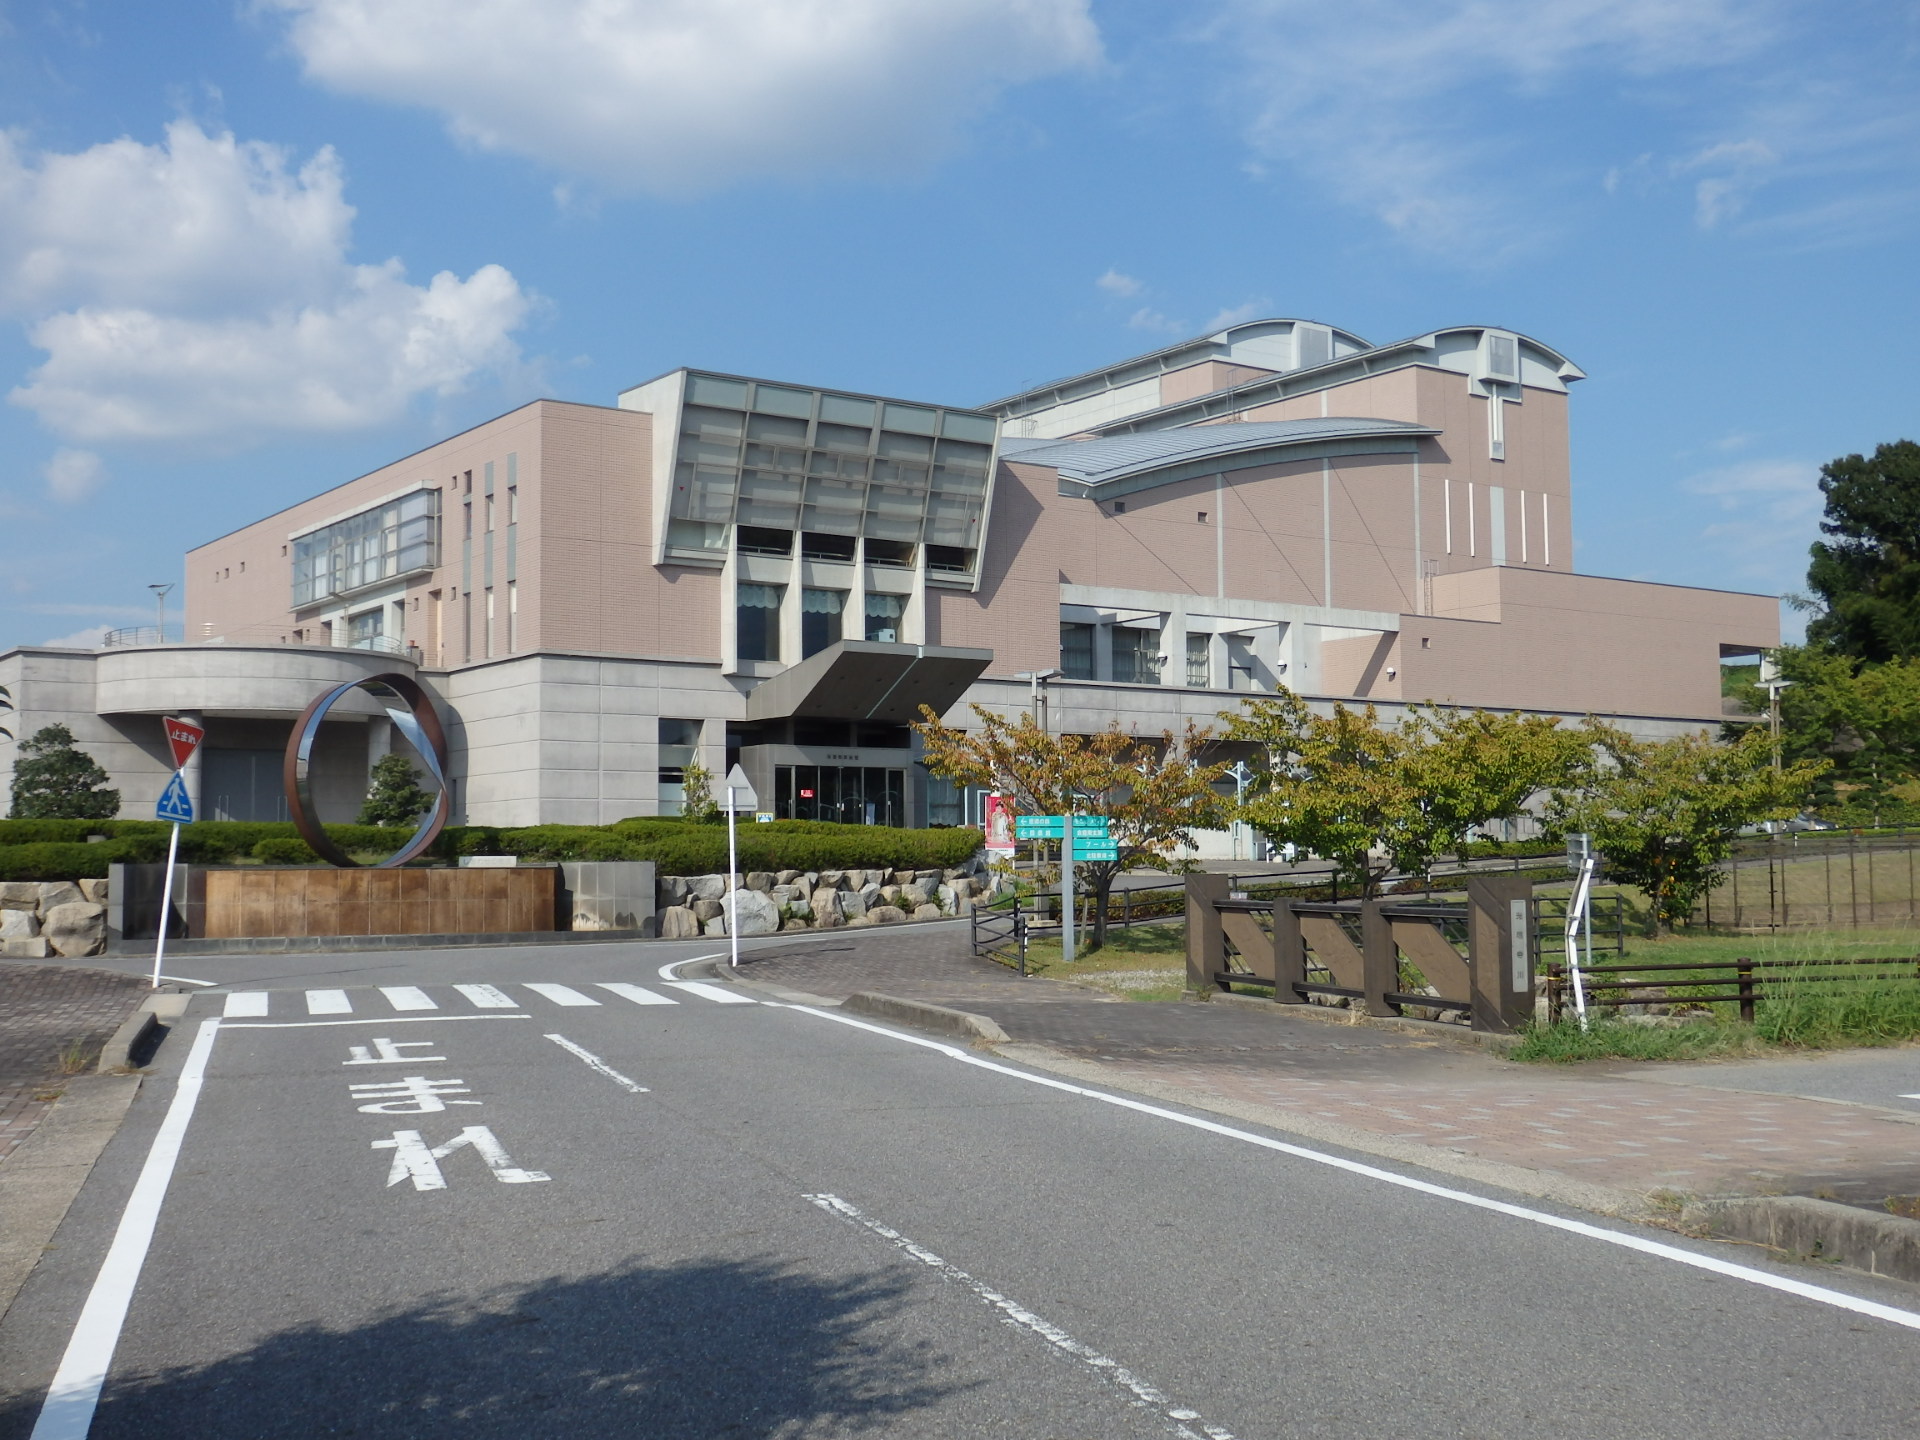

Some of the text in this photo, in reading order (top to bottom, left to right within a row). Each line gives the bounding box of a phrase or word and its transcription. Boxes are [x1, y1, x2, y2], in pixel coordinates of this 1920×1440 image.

[170, 729, 197, 745] 止まれ
[342, 1037, 552, 1191] 止まれ
